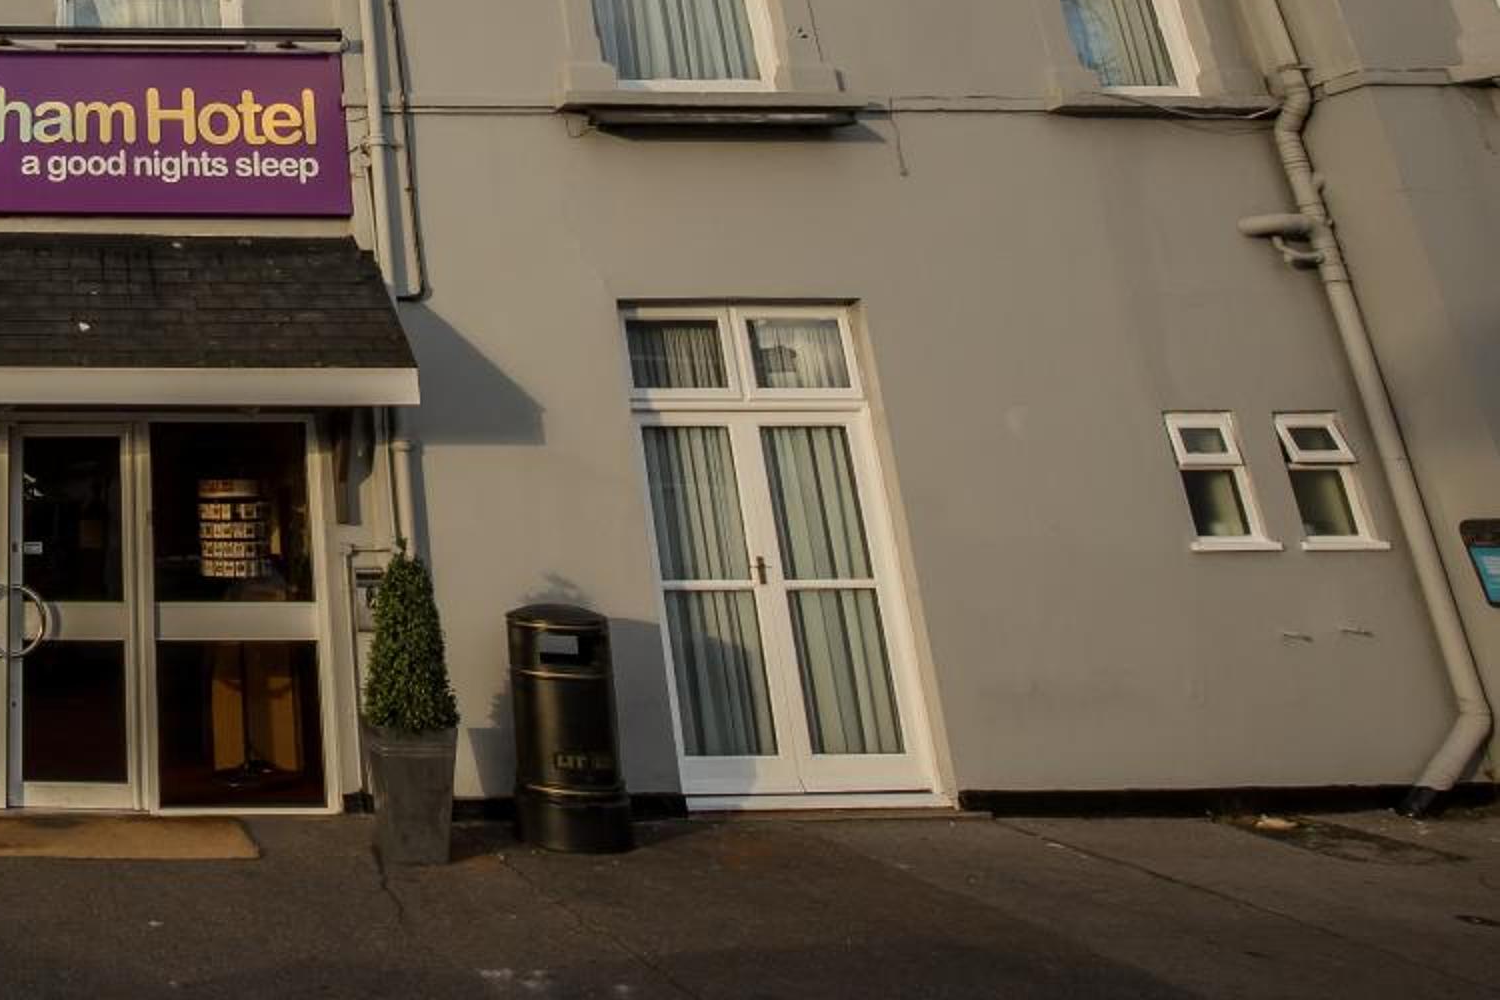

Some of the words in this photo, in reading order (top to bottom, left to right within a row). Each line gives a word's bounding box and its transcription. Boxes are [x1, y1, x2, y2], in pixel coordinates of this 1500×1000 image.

[145, 87, 318, 145] Hotel
[21, 154, 41, 176] a
[47, 149, 126, 182] good
[133, 150, 229, 183] nights
[235, 151, 319, 184] sleep
